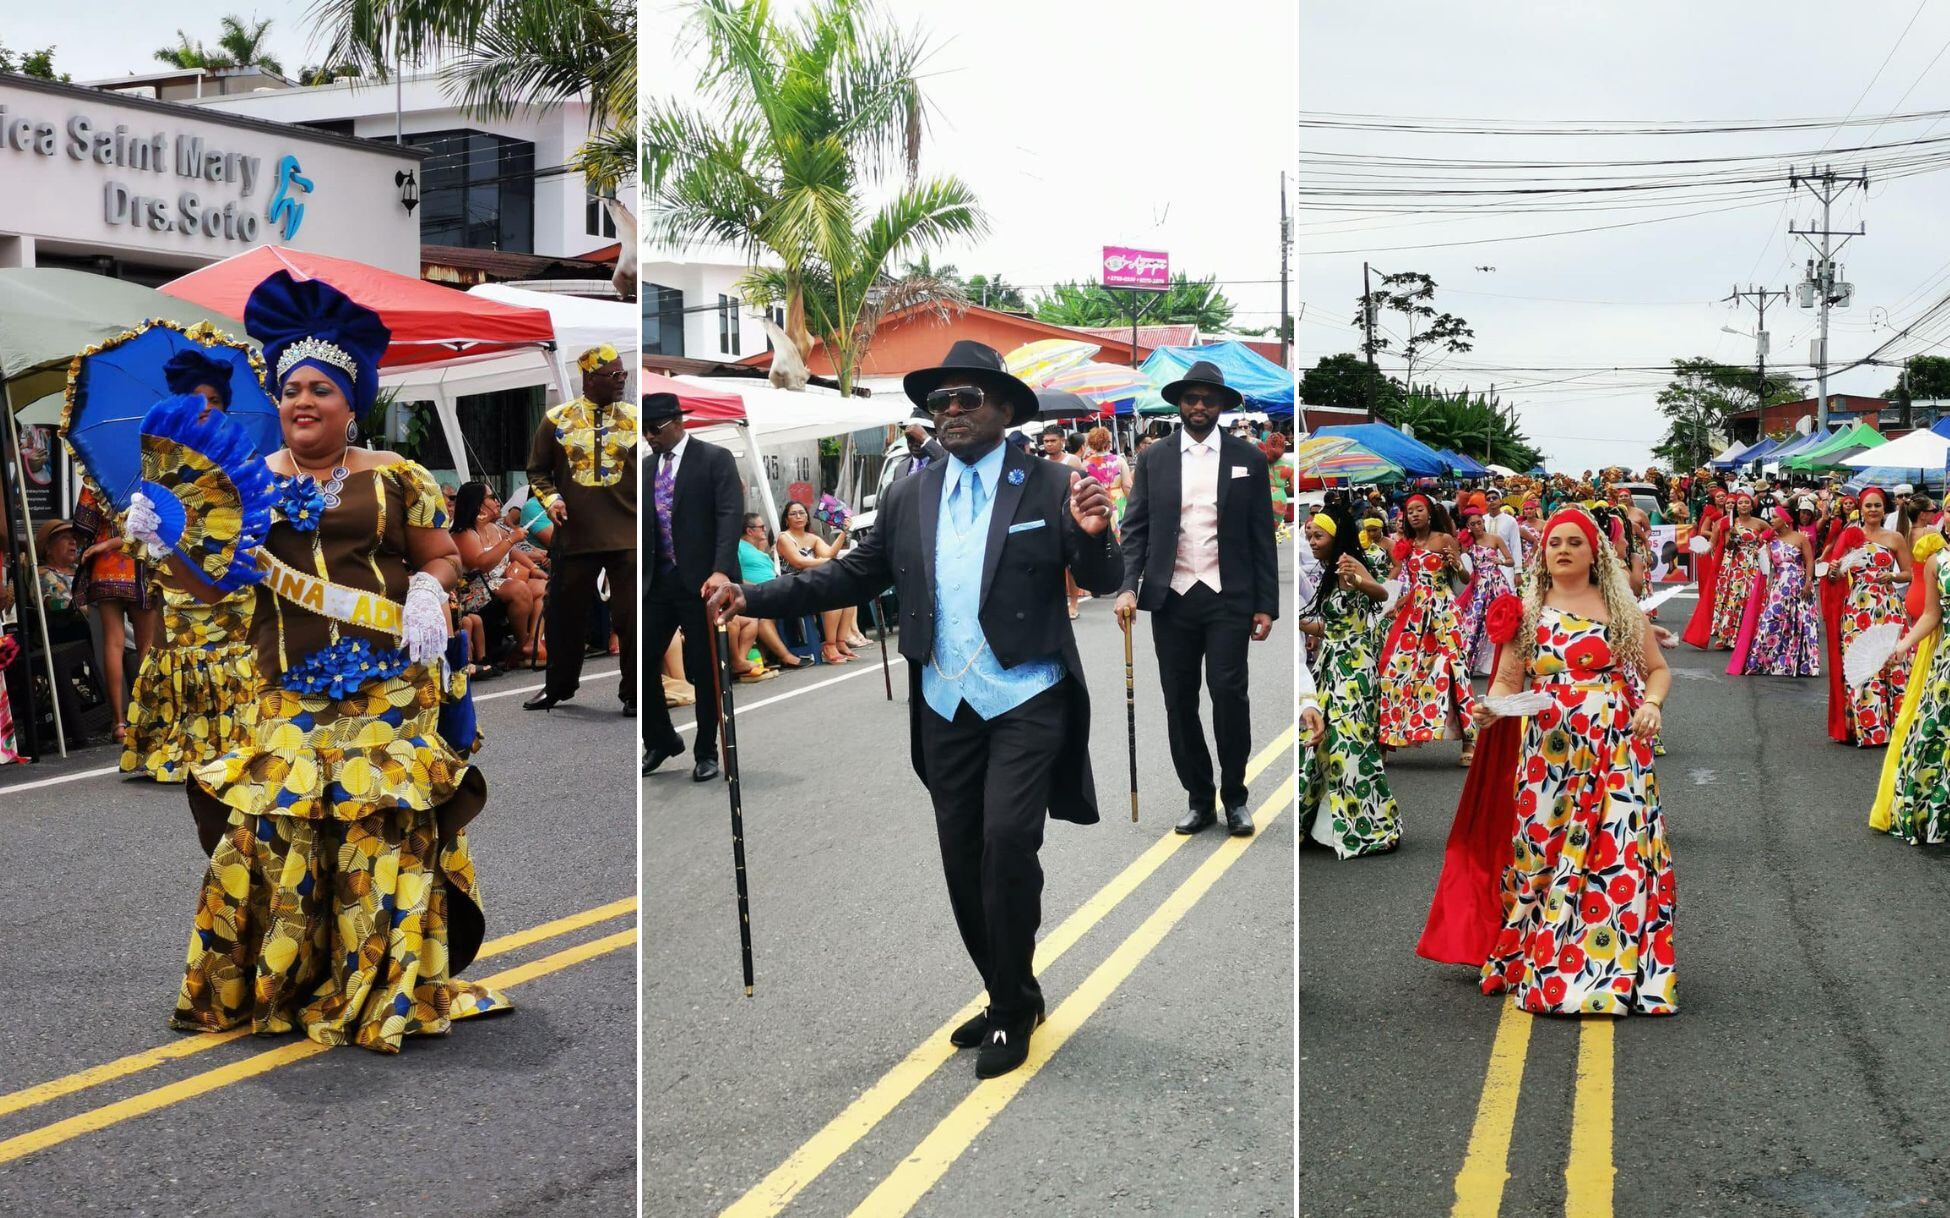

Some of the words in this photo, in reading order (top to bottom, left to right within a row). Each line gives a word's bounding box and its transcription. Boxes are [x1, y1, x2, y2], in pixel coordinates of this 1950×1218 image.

[66, 115, 168, 170] Saint
[176, 134, 261, 197] Mary
[796, 457, 810, 481] 10
